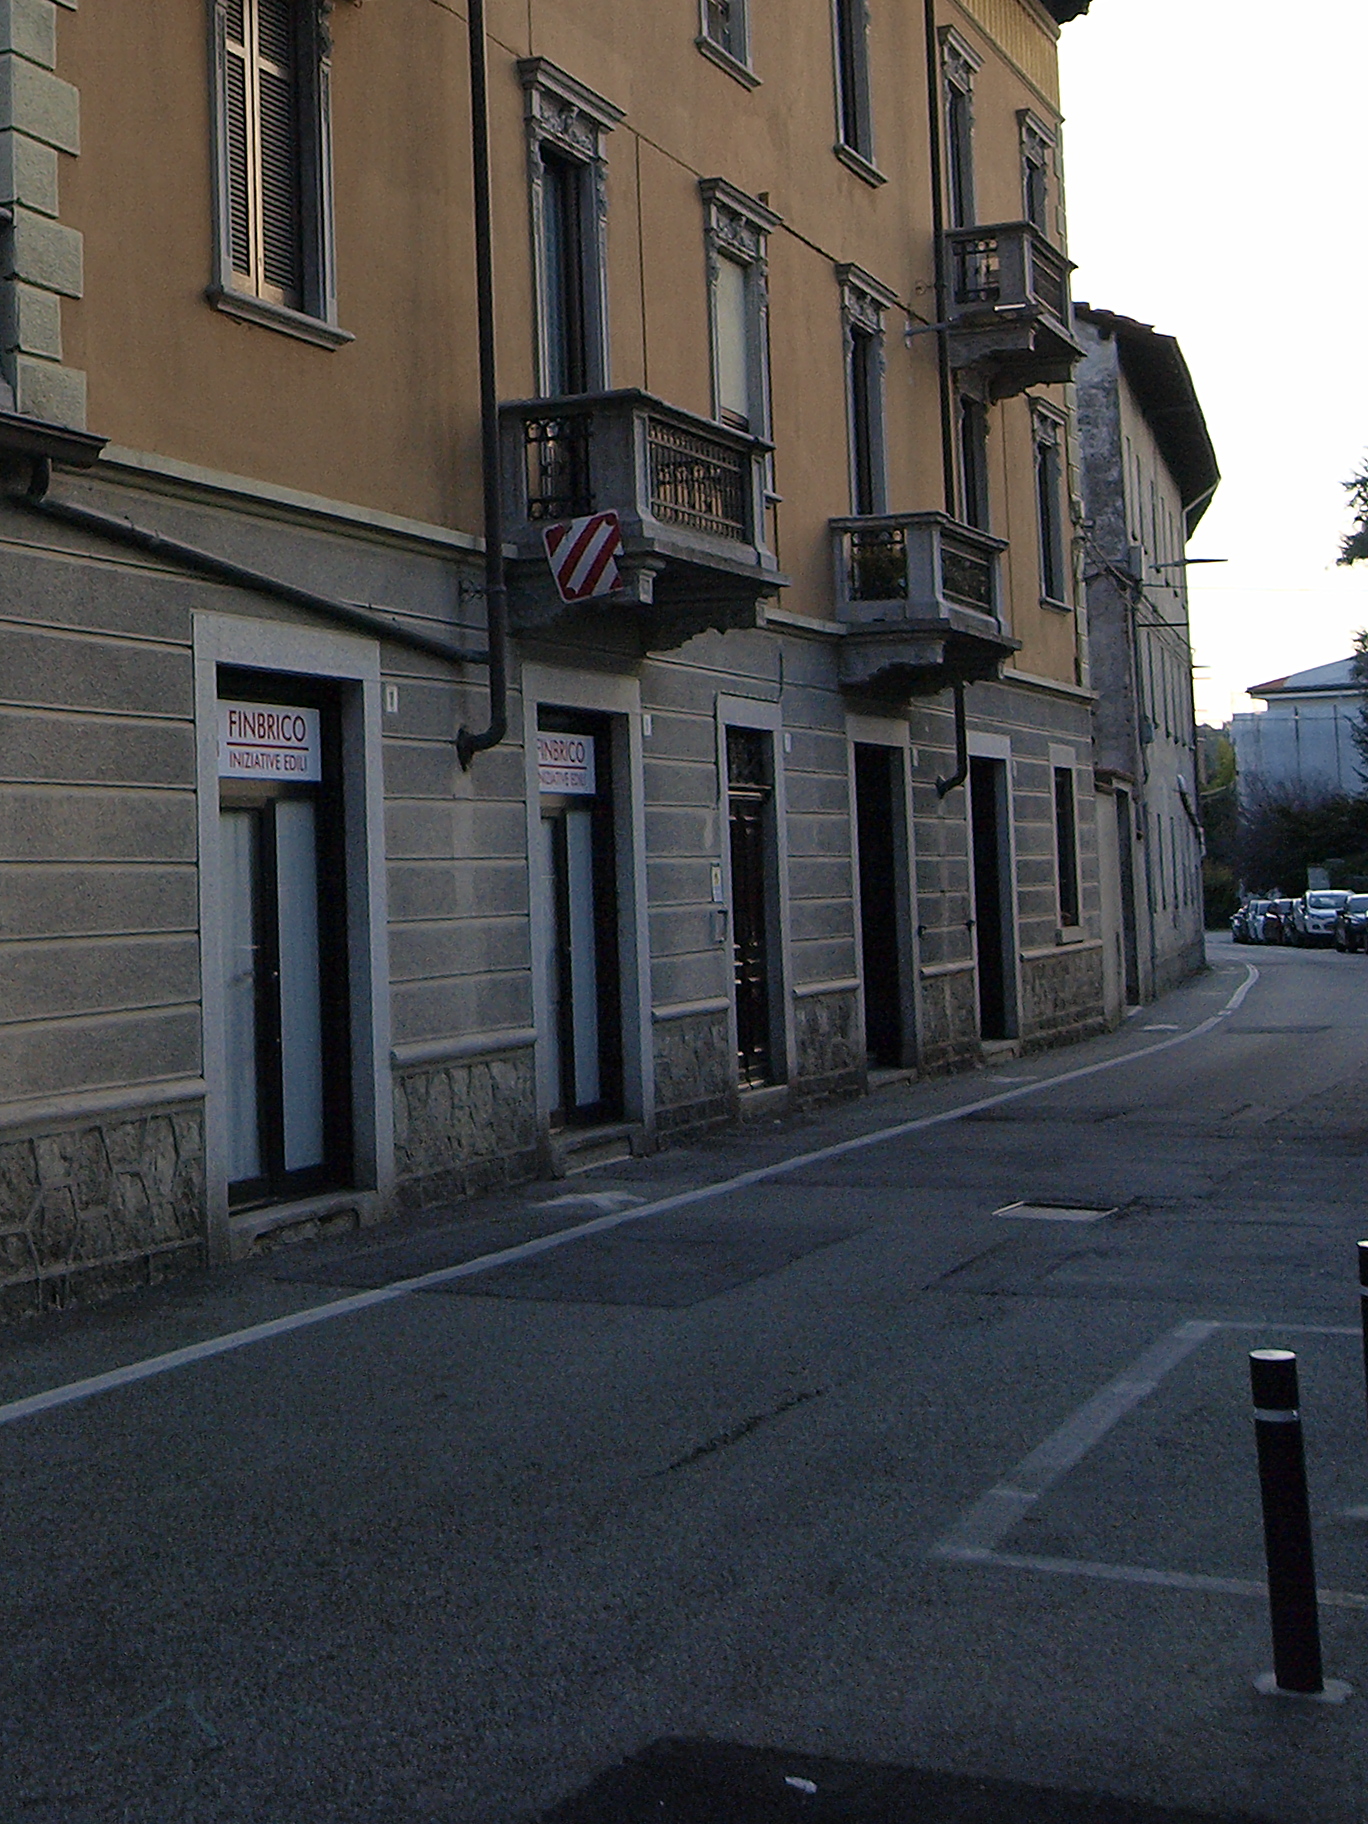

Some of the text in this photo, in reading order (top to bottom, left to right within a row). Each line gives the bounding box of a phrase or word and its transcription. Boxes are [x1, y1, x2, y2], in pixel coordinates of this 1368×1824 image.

[229, 709, 306, 742] FINBRICO
[229, 751, 307, 772] INIZIATIVE EDILI
